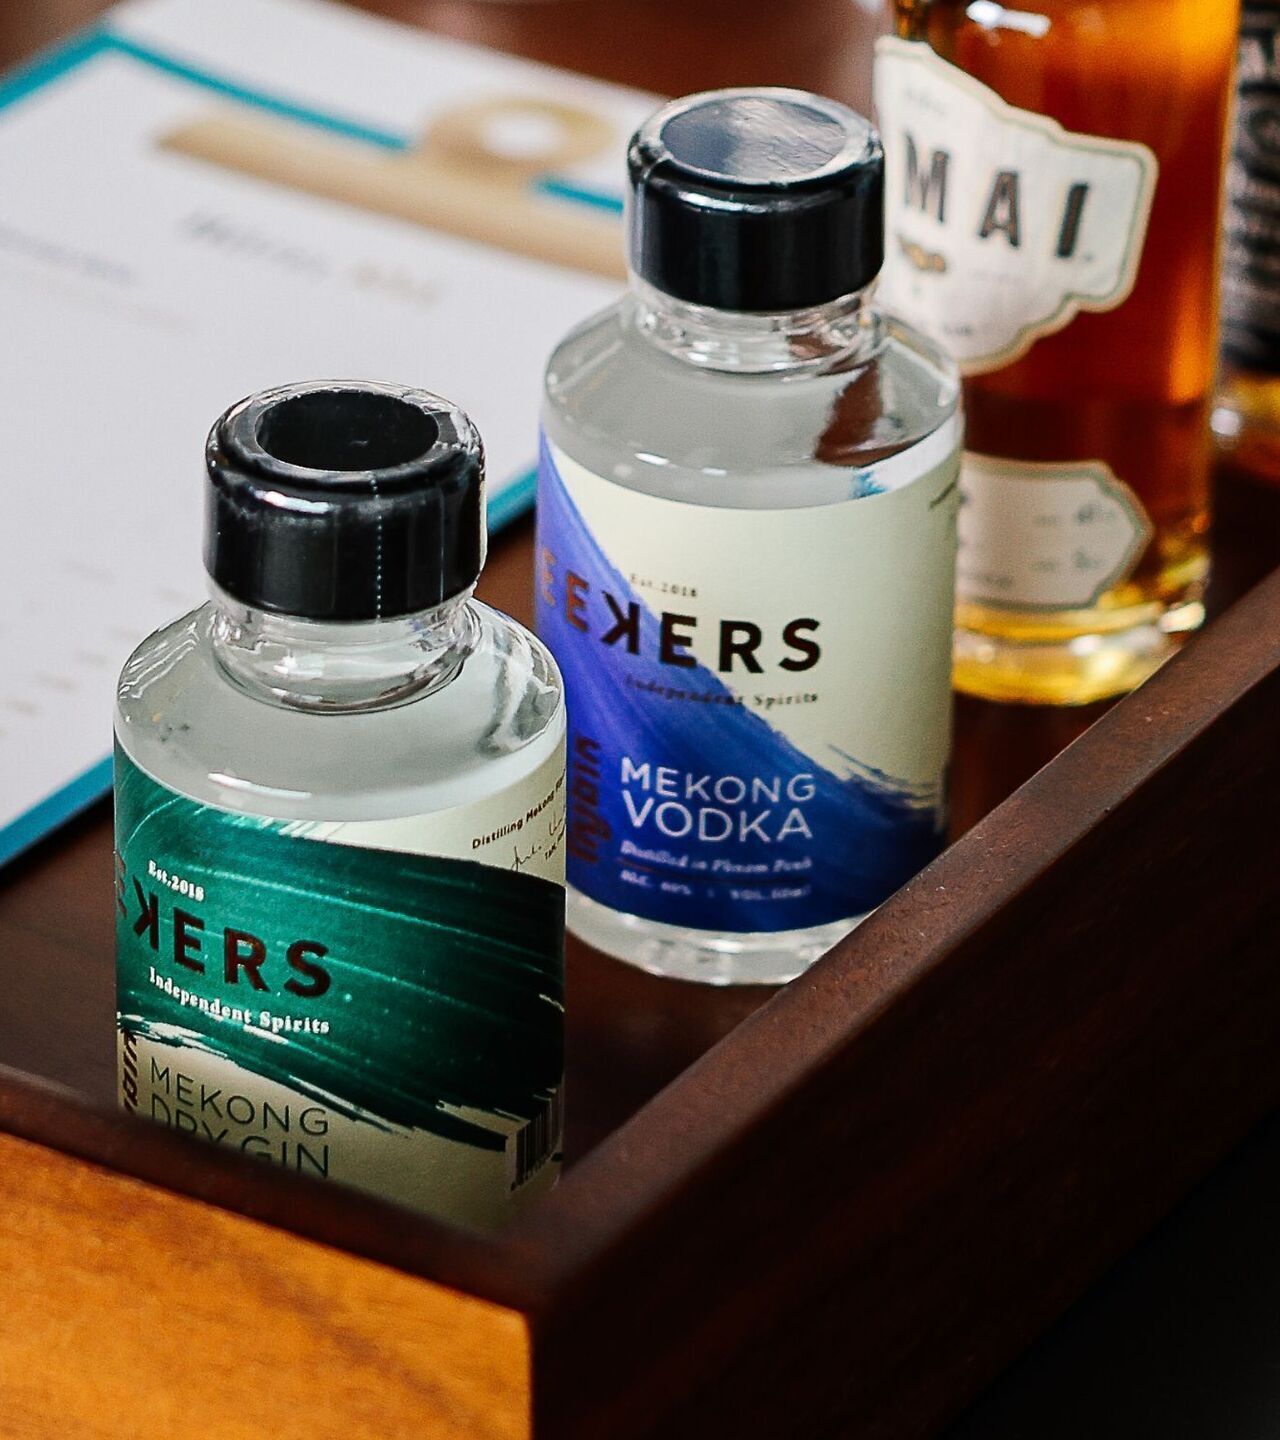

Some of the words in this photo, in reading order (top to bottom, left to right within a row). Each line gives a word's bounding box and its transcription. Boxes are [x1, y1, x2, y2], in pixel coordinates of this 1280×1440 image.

[752, 692, 819, 711] Spirits
[620, 756, 816, 804] MEKONG
[471, 818, 524, 850] Distilling
[621, 790, 814, 842] VODKA
[147, 860, 205, 903] Est.2018
[148, 966, 252, 1025] Independent
[258, 1010, 331, 1036] Spirits
[150, 1056, 330, 1136] MEKONG
